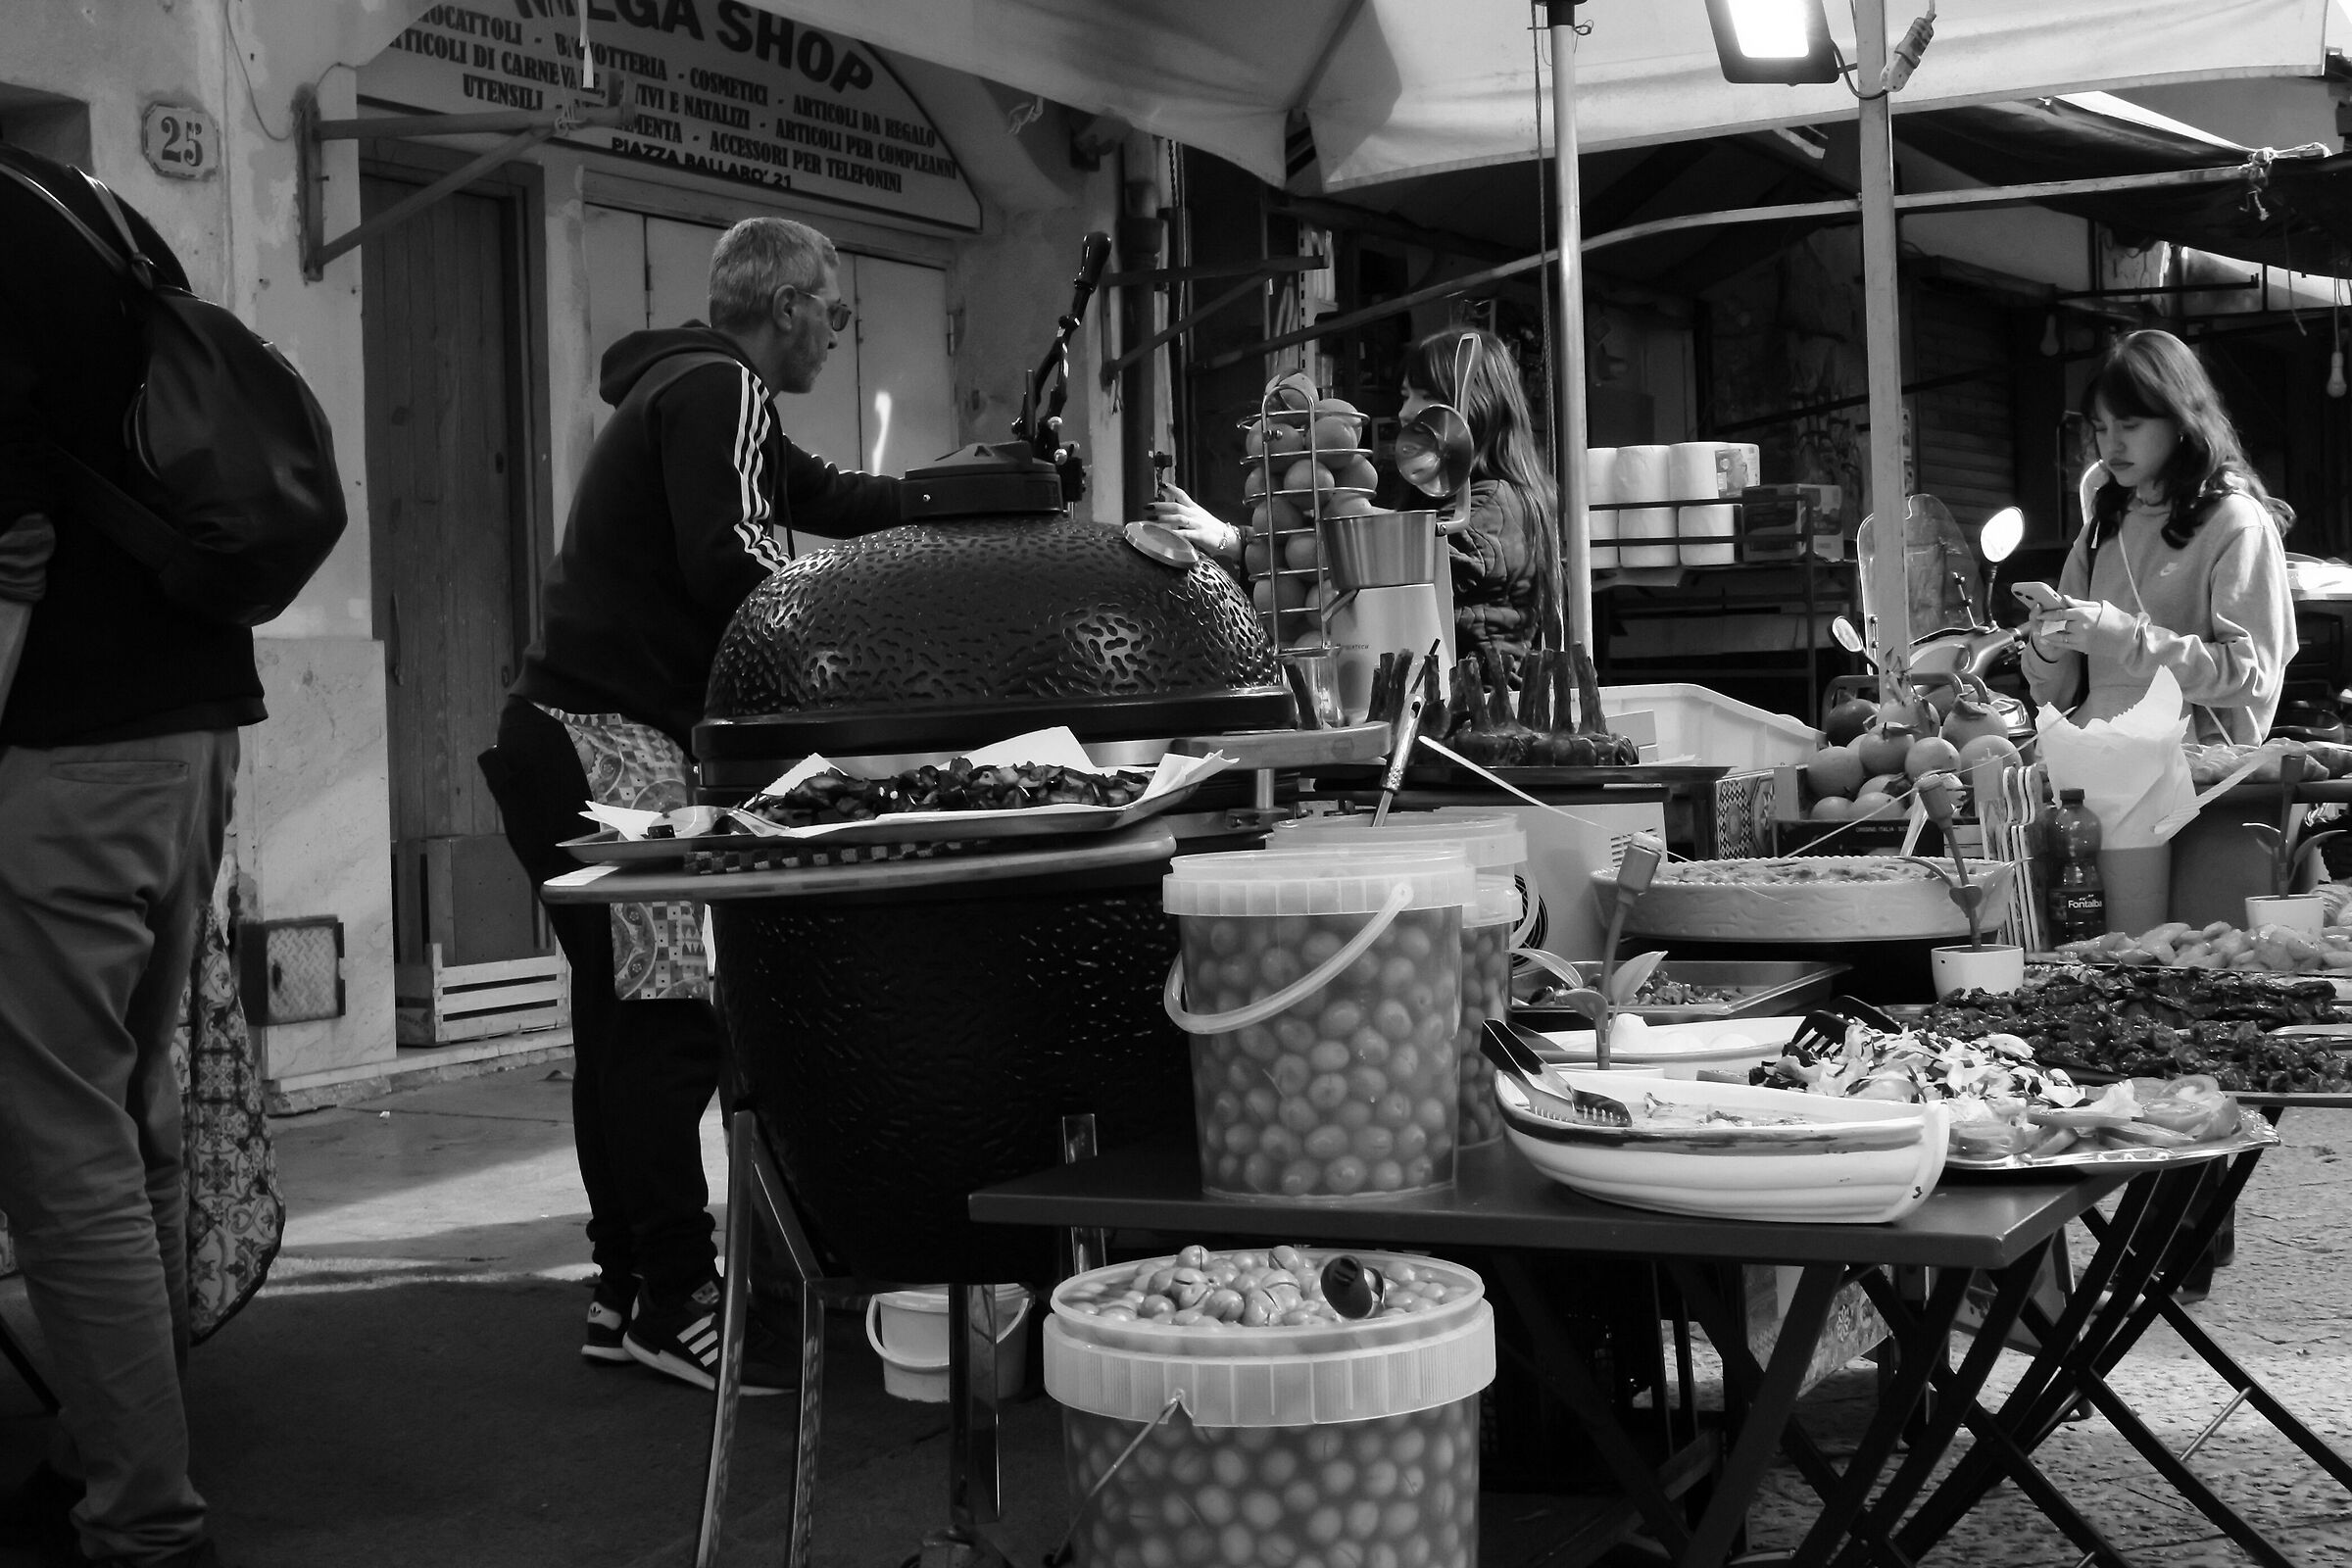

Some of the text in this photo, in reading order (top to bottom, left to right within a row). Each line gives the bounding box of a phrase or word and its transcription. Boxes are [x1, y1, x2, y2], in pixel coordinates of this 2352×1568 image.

[416, 4, 522, 46] OCATTOLI
[690, 68, 768, 107] COSMETICI
[794, 95, 858, 128] ARTICOLI
[862, 112, 881, 134] DA
[885, 118, 936, 148] REGALO
[716, 0, 873, 93] SHOP
[161, 116, 204, 167] 25
[388, 27, 467, 65] TICOLI
[473, 43, 495, 71] DI
[669, 91, 679, 114] E
[684, 94, 750, 130] NATALIZI
[775, 118, 842, 152] ARTICOLI
[847, 134, 873, 160] PER
[877, 143, 957, 179] COMPLEANNI
[463, 74, 544, 110] UTENSILI
[710, 129, 788, 168] ACCESSORI
[793, 150, 821, 174] PER
[826, 158, 903, 193] TELEFONINI
[612, 137, 680, 166] PIAZZA
[773, 172, 791, 188] 21
